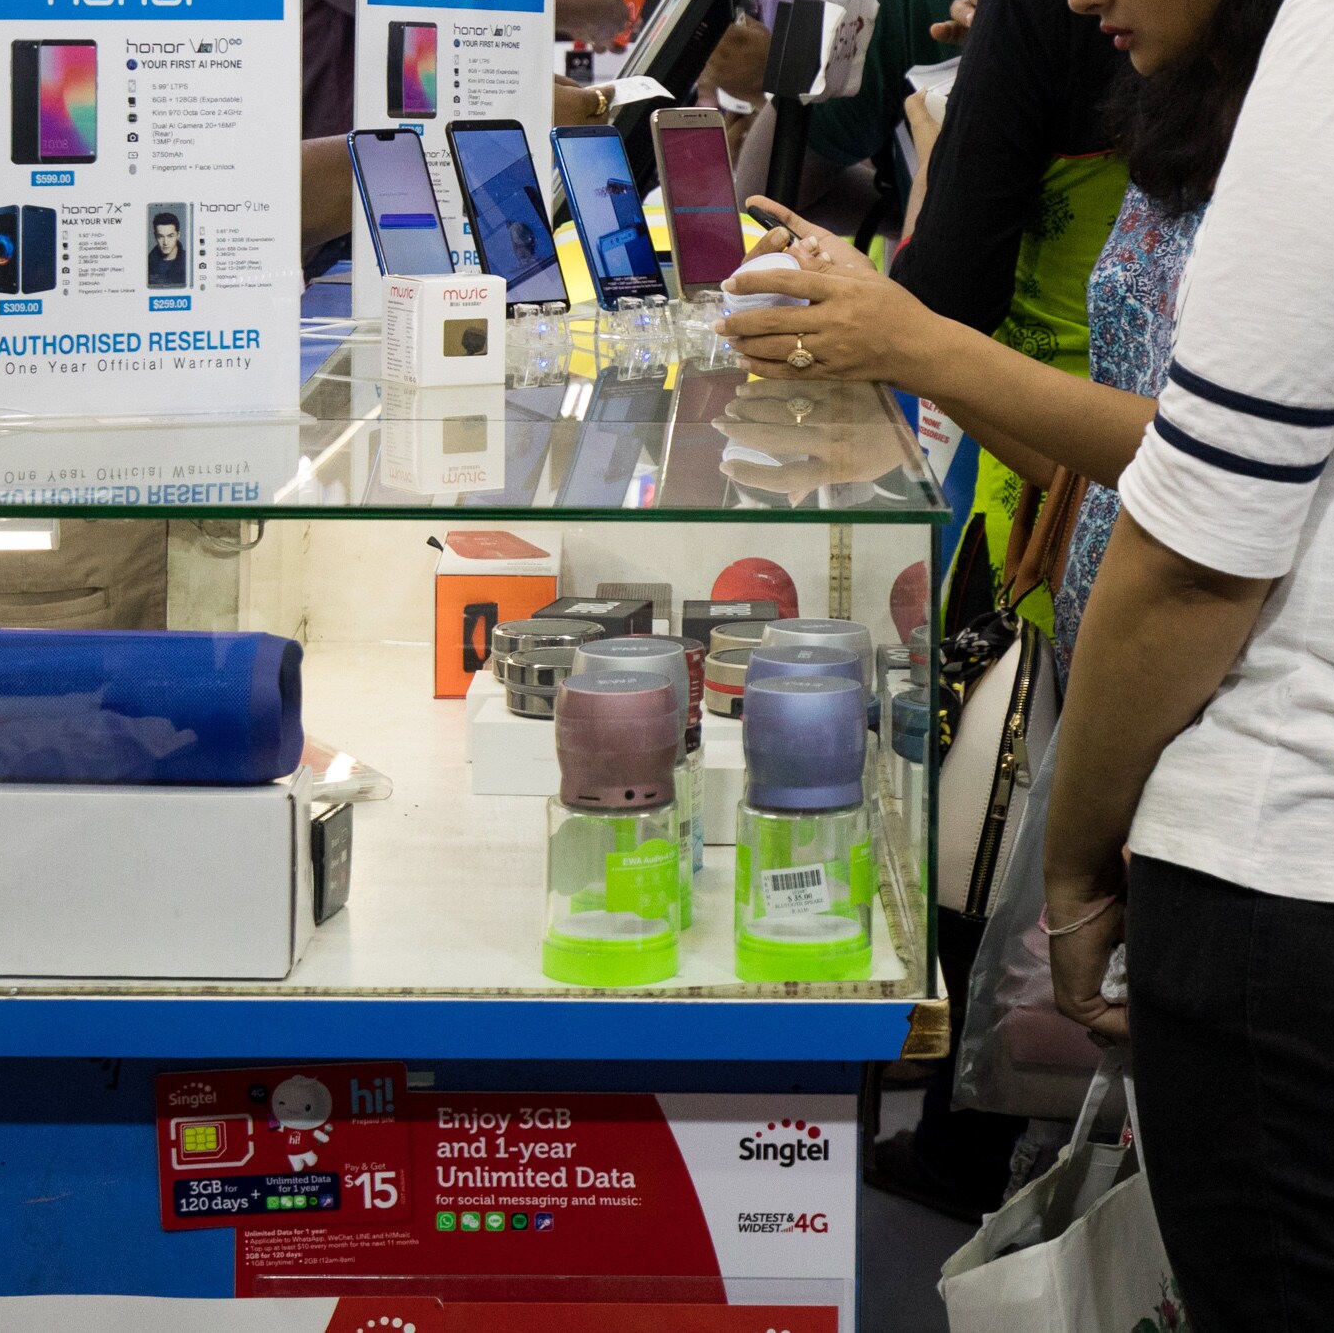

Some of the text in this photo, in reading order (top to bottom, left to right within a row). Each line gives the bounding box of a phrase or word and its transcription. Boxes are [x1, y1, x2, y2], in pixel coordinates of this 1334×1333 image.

[453, 22, 488, 36] honor
[126, 38, 186, 54] honor
[462, 40, 520, 49] YOUR FIRST PHONE
[141, 60, 243, 69] YOUR FIRST PHONE
[35, 173, 72, 185] $599.00
[62, 203, 103, 215] honor
[200, 202, 270, 213] honor Lite
[62, 218, 78, 226] MAX
[390, 285, 414, 301] music
[443, 287, 488, 303] music
[3, 302, 39, 313] $309.00
[153, 299, 188, 310] $259.00
[149, 329, 261, 351] RESELLER
[5, 357, 252, 376] One Year Official Warranty
[169, 1077, 395, 1115] Singtel hi!
[436, 1107, 572, 1134] Enjoy 3GB
[436, 1137, 577, 1163] and 1-year
[739, 1137, 830, 1167] Singtel
[345, 1162, 387, 1172] Pay Get
[266, 1175, 332, 1185] Unlimited Data
[436, 1167, 637, 1189] Unlimited Data
[189, 1180, 238, 1194] 3GB for
[278, 1184, 320, 1193] for year
[345, 1171, 398, 1209] $15
[180, 1196, 249, 1212] 120 days
[435, 1193, 642, 1208] for social messaging and music:
[738, 1213, 786, 1223] FASTEST
[738, 1213, 829, 1234] WIDEST 4G
